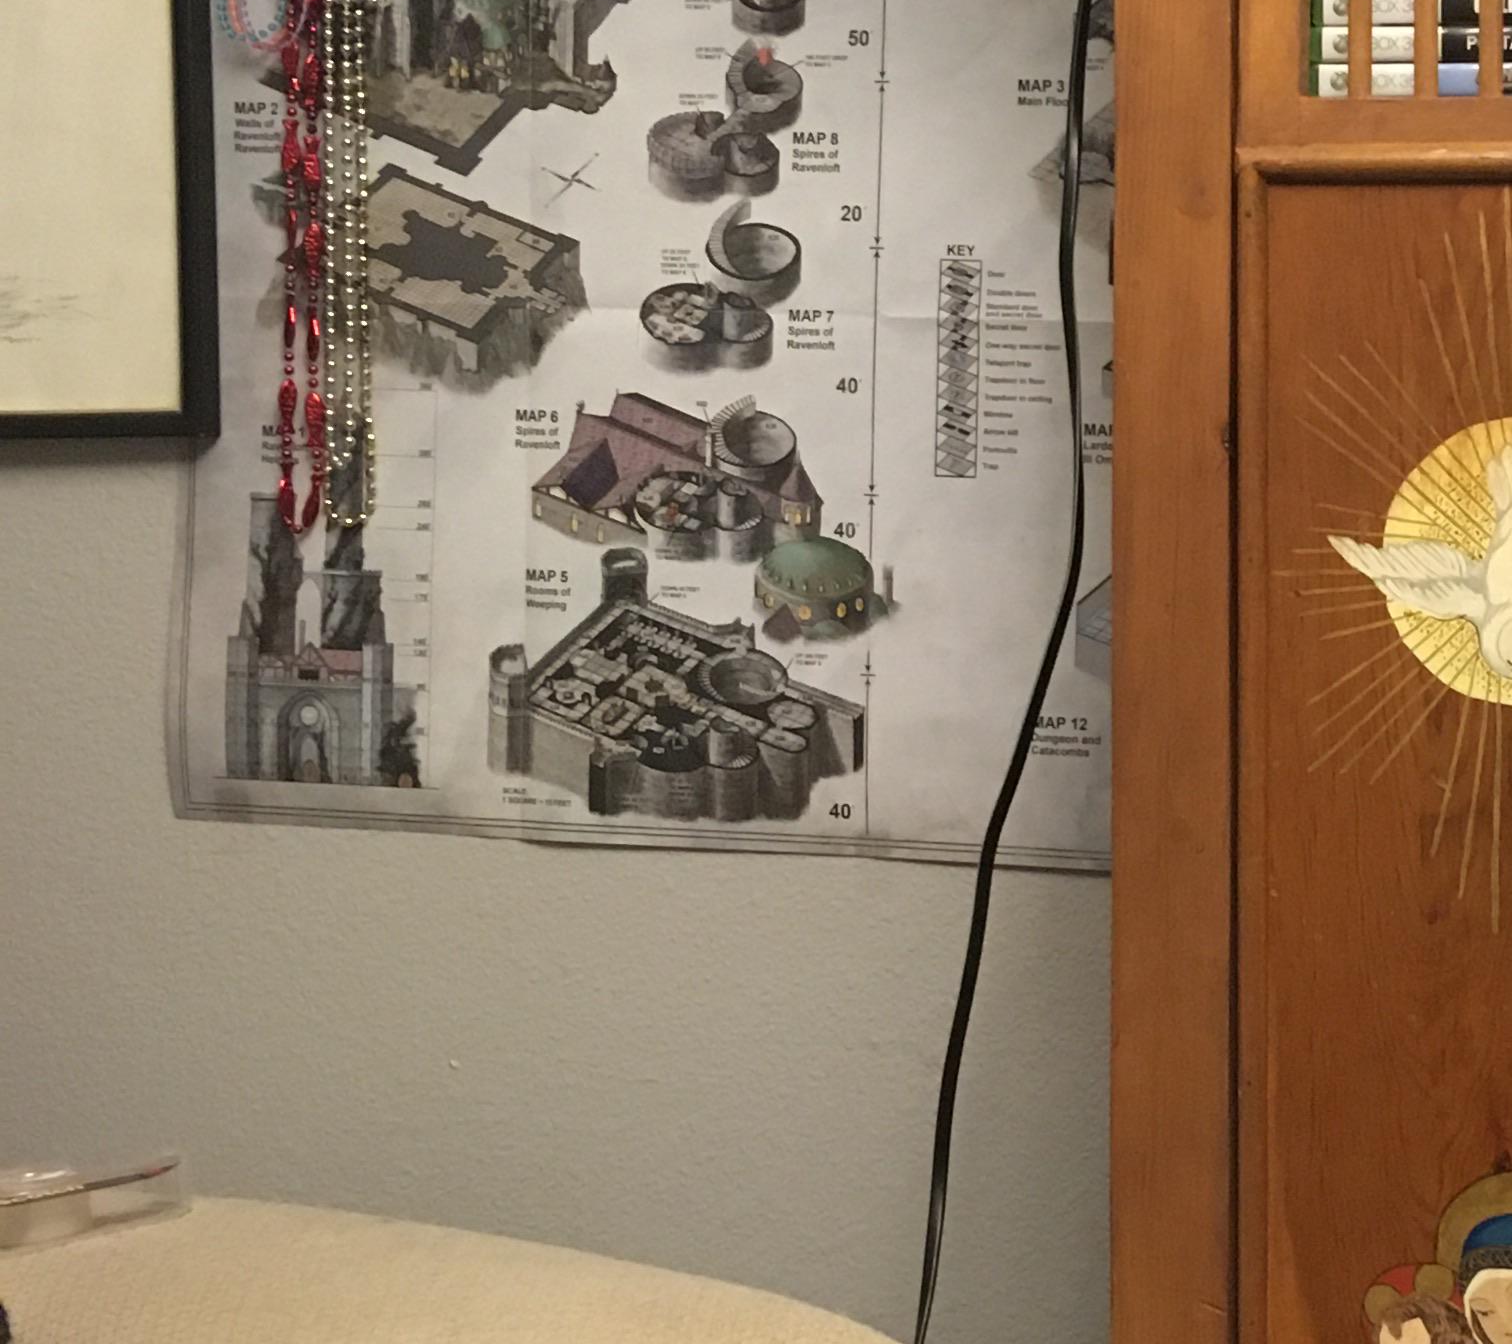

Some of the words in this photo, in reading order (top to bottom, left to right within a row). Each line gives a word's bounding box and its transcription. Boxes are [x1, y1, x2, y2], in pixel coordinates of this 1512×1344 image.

[1018, 79, 1053, 93] MAP
[1056, 80, 1065, 93] 3
[234, 102, 266, 115] MAP
[270, 102, 279, 116] 2
[792, 131, 827, 145] MAP
[830, 132, 839, 145] 8
[792, 148, 825, 161] Spires
[827, 149, 839, 160] of
[947, 244, 975, 257] KEY
[788, 309, 823, 323] MAP
[826, 310, 835, 323] 7
[787, 326, 821, 338] Spires
[823, 326, 834, 337] of
[787, 339, 836, 351] Ravenloft
[515, 409, 548, 422] MAP
[550, 410, 559, 423] 6
[525, 568, 557, 582] MAP
[560, 570, 569, 583] 5
[1071, 717, 1088, 732] 12
